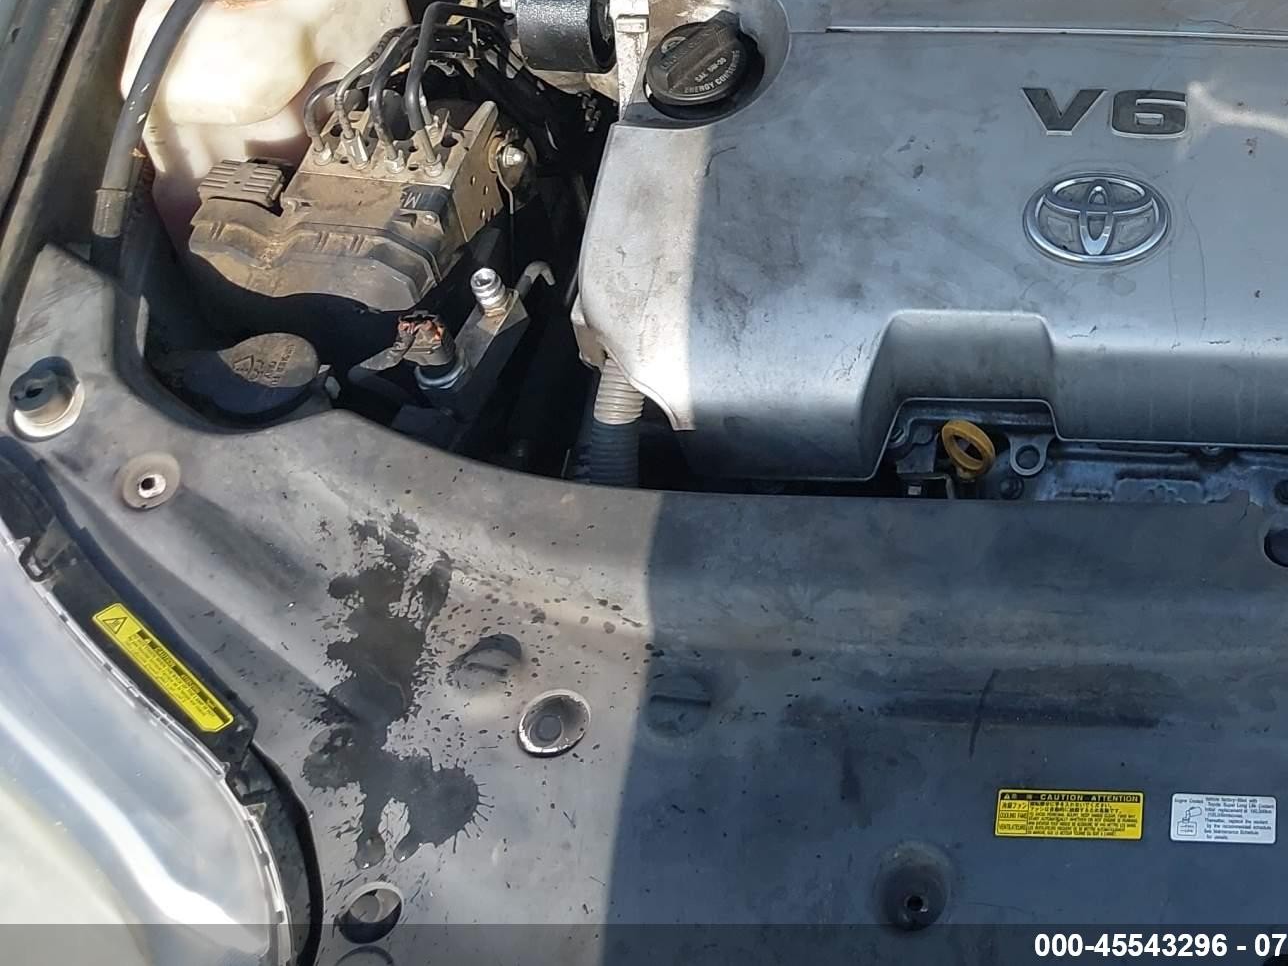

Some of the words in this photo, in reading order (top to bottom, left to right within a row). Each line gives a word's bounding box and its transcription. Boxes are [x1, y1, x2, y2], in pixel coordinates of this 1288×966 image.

[1021, 87, 1187, 139] V6
[1040, 793, 1084, 801] CAUTION
[1091, 794, 1139, 802] ATTENTION
